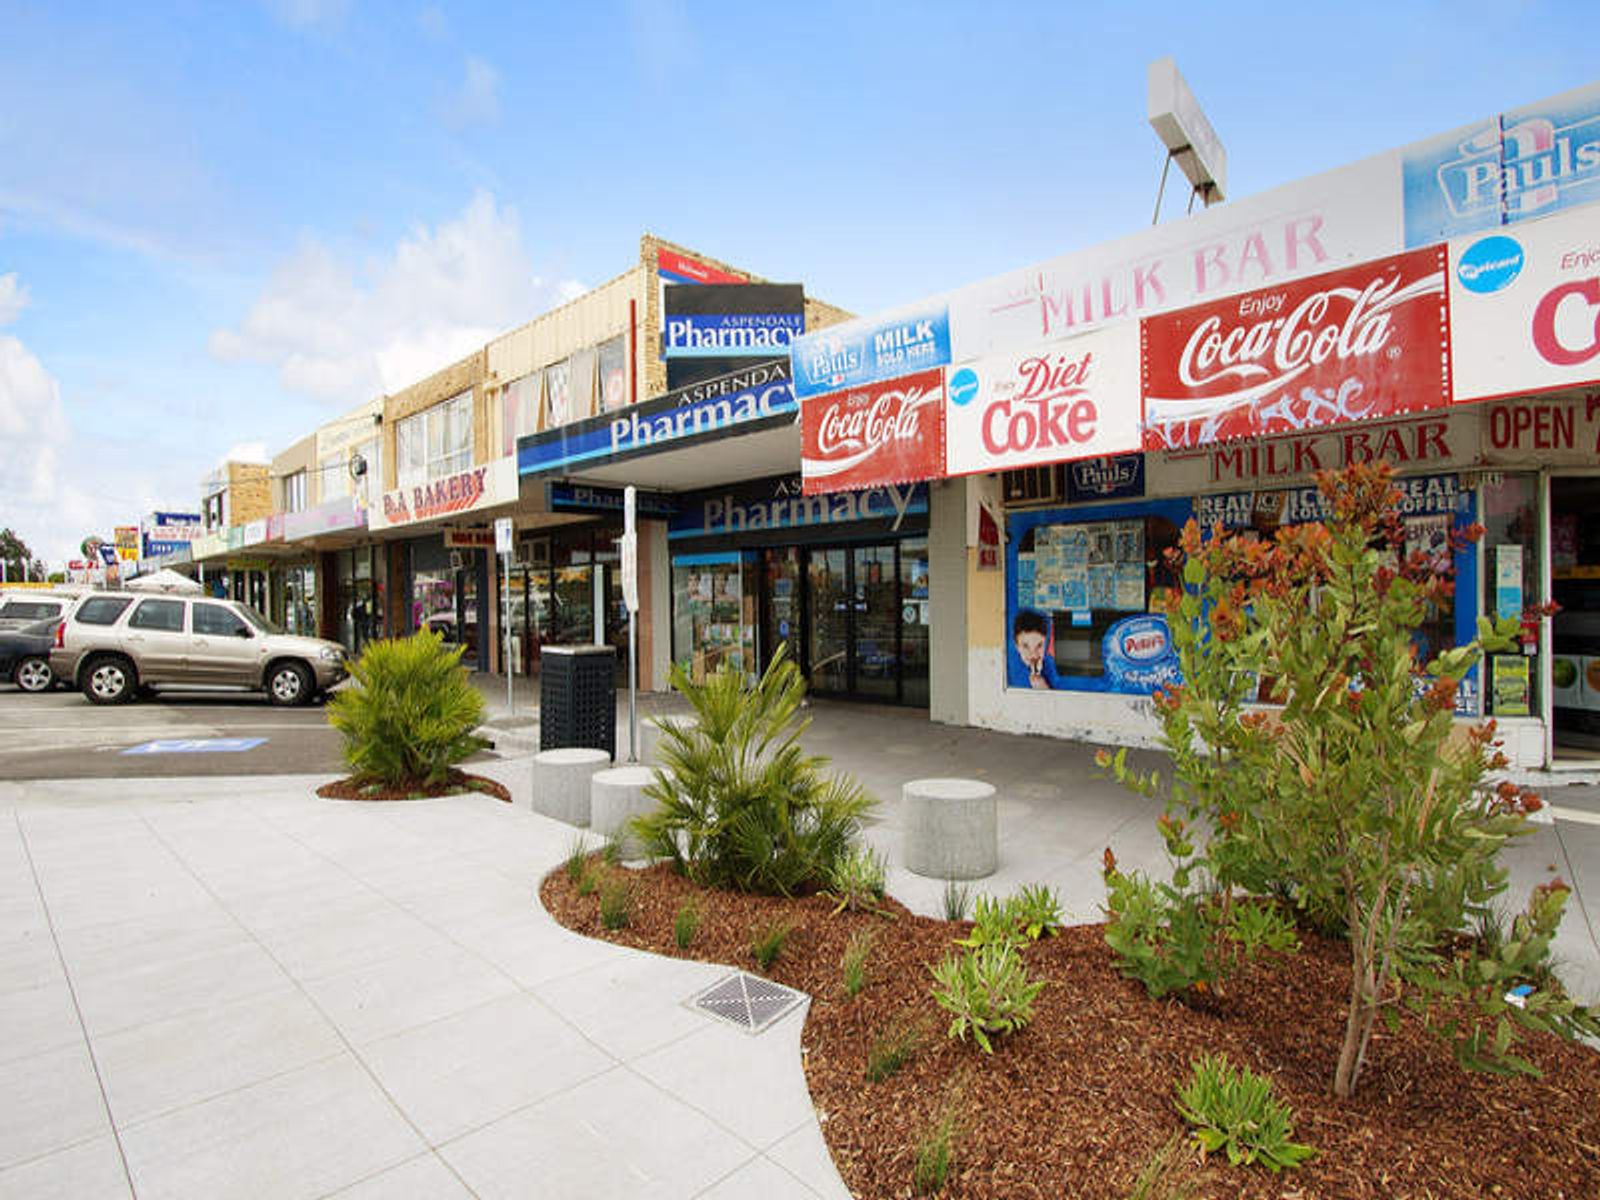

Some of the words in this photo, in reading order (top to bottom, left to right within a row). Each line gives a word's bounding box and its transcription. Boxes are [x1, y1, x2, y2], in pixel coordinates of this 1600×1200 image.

[1464, 136, 1600, 204] Pauls
[1040, 259, 1167, 336] MILK
[1194, 214, 1330, 294] BAR
[1239, 291, 1287, 316] Enjoy
[874, 320, 935, 353] MILK
[1178, 272, 1397, 387] Coca-Cola
[677, 364, 786, 407] ASPENDA
[1013, 352, 1093, 399] Diet
[818, 386, 922, 454] Coca-Cola
[982, 399, 1097, 455] Coke
[1490, 405, 1573, 449] OPEN
[1081, 463, 1130, 485] Pauls
[1213, 437, 1323, 480] MILK
[1343, 422, 1452, 466] BAR
[414, 467, 487, 511] BAKERY
[704, 484, 915, 534] Pharmacy
[1201, 495, 1252, 512] REAL
